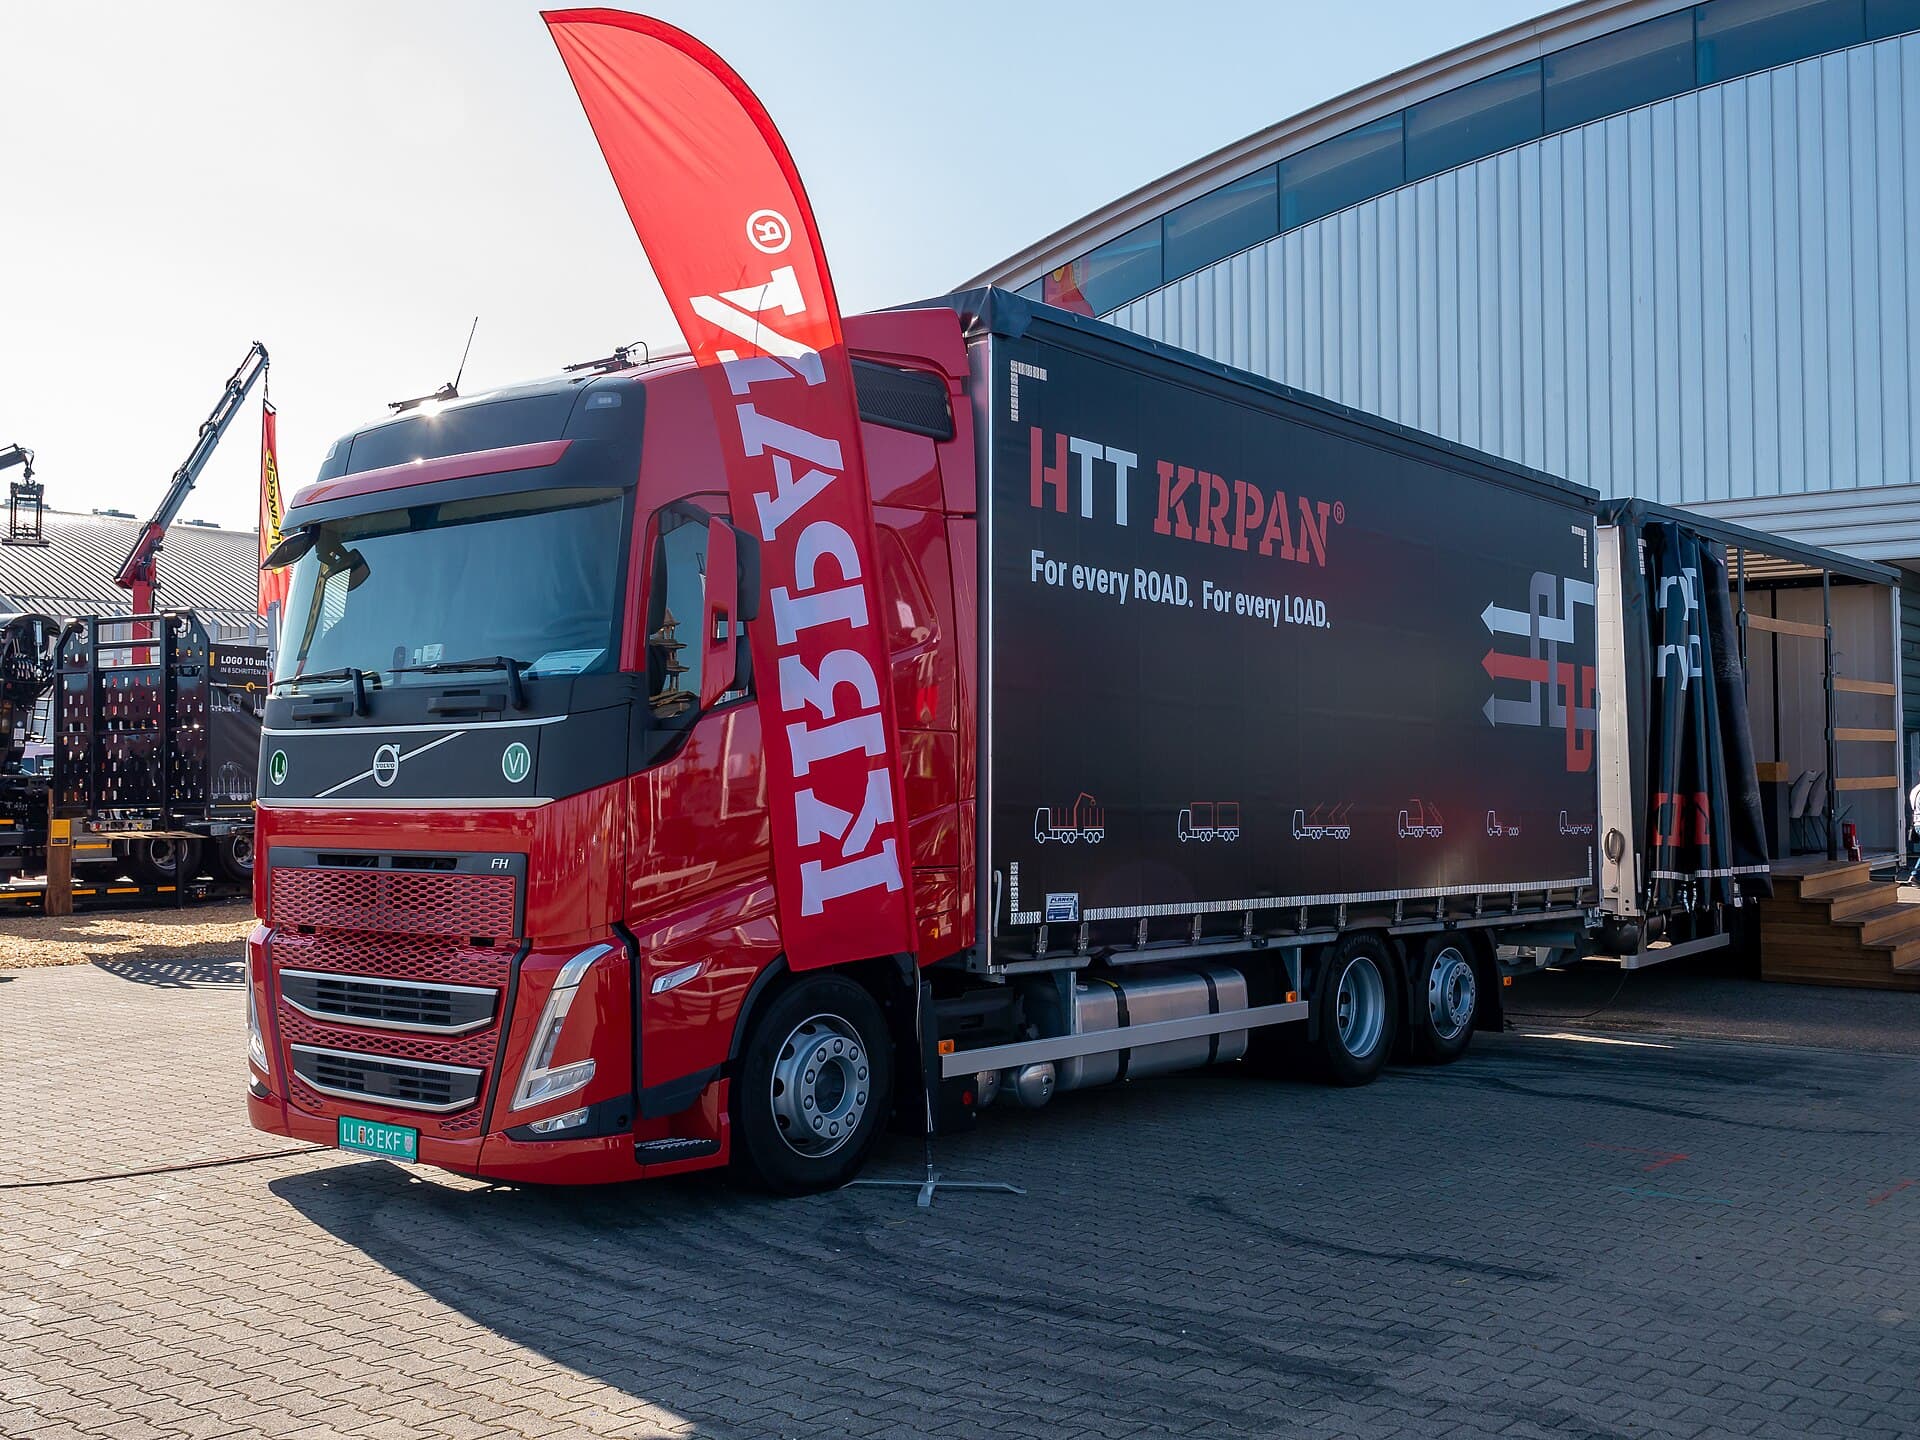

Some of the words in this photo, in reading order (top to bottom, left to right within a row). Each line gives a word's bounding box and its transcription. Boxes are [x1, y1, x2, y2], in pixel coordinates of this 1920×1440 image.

[1030, 426, 1138, 527] HTT
[1031, 549, 1068, 586] For
[1072, 564, 1129, 605] every
[1134, 568, 1194, 608] ROAD.
[1203, 580, 1233, 614] For
[1236, 591, 1281, 628] every
[1285, 594, 1331, 629] LOAD.
[221, 655, 243, 665] LOGO
[244, 657, 254, 666] 10
[508, 752, 524, 774] VI
[491, 858, 509, 869] FH
